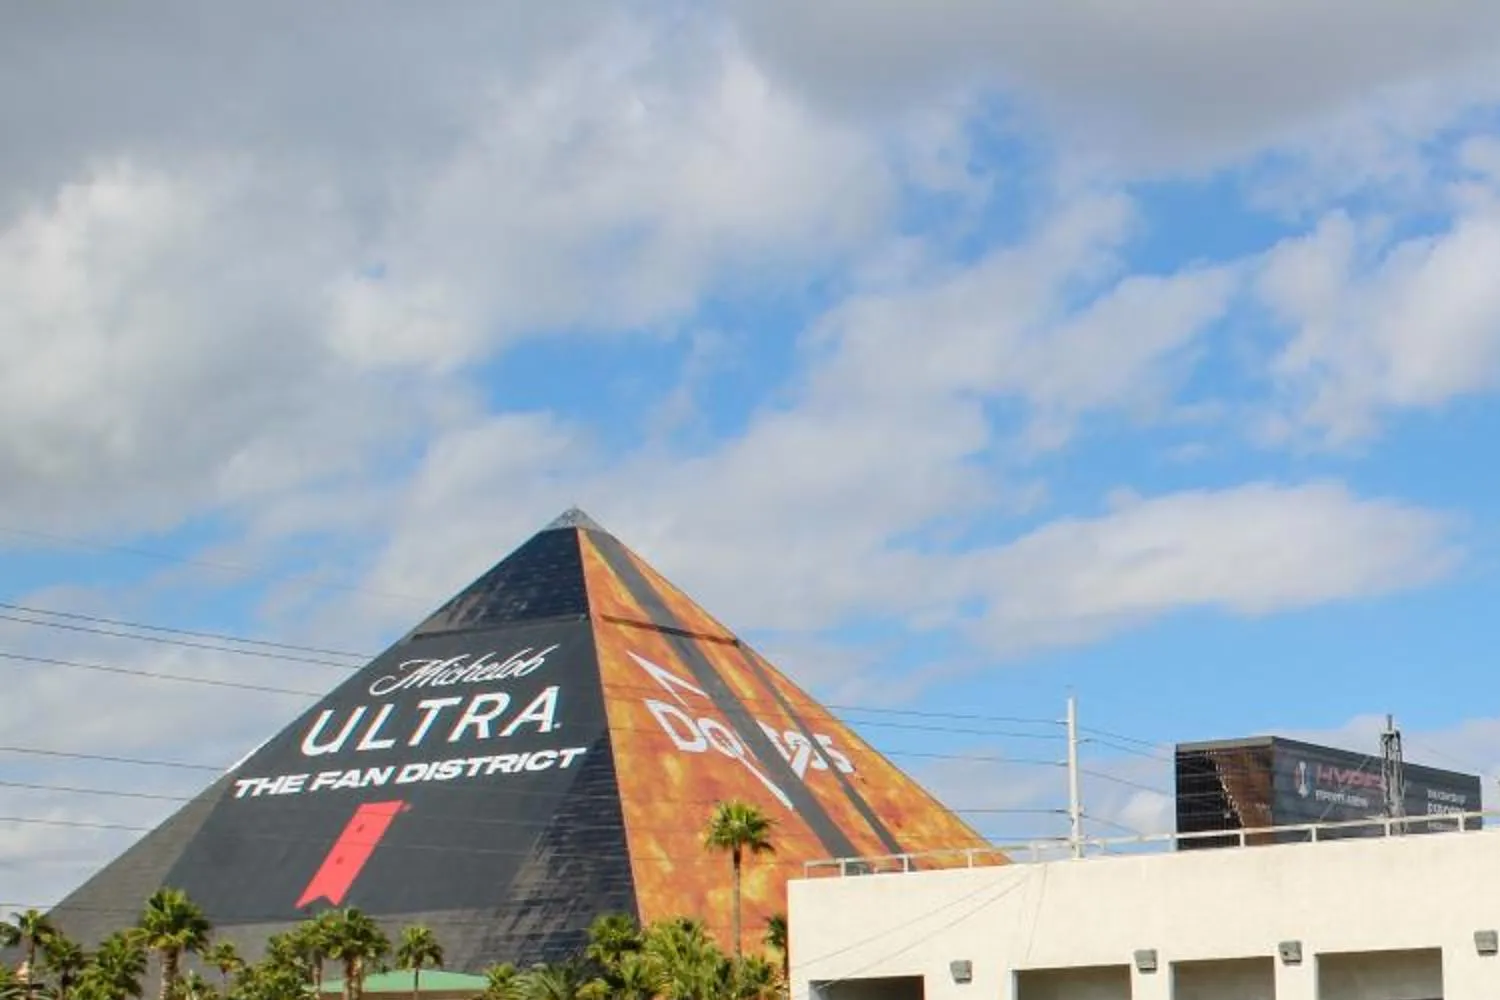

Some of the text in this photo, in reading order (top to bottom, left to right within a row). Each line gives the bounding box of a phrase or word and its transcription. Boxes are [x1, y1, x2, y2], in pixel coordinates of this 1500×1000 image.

[369, 643, 560, 695] Michelob
[300, 686, 561, 757] ULTRA
[234, 747, 588, 798] THE FAN DISTRICT
